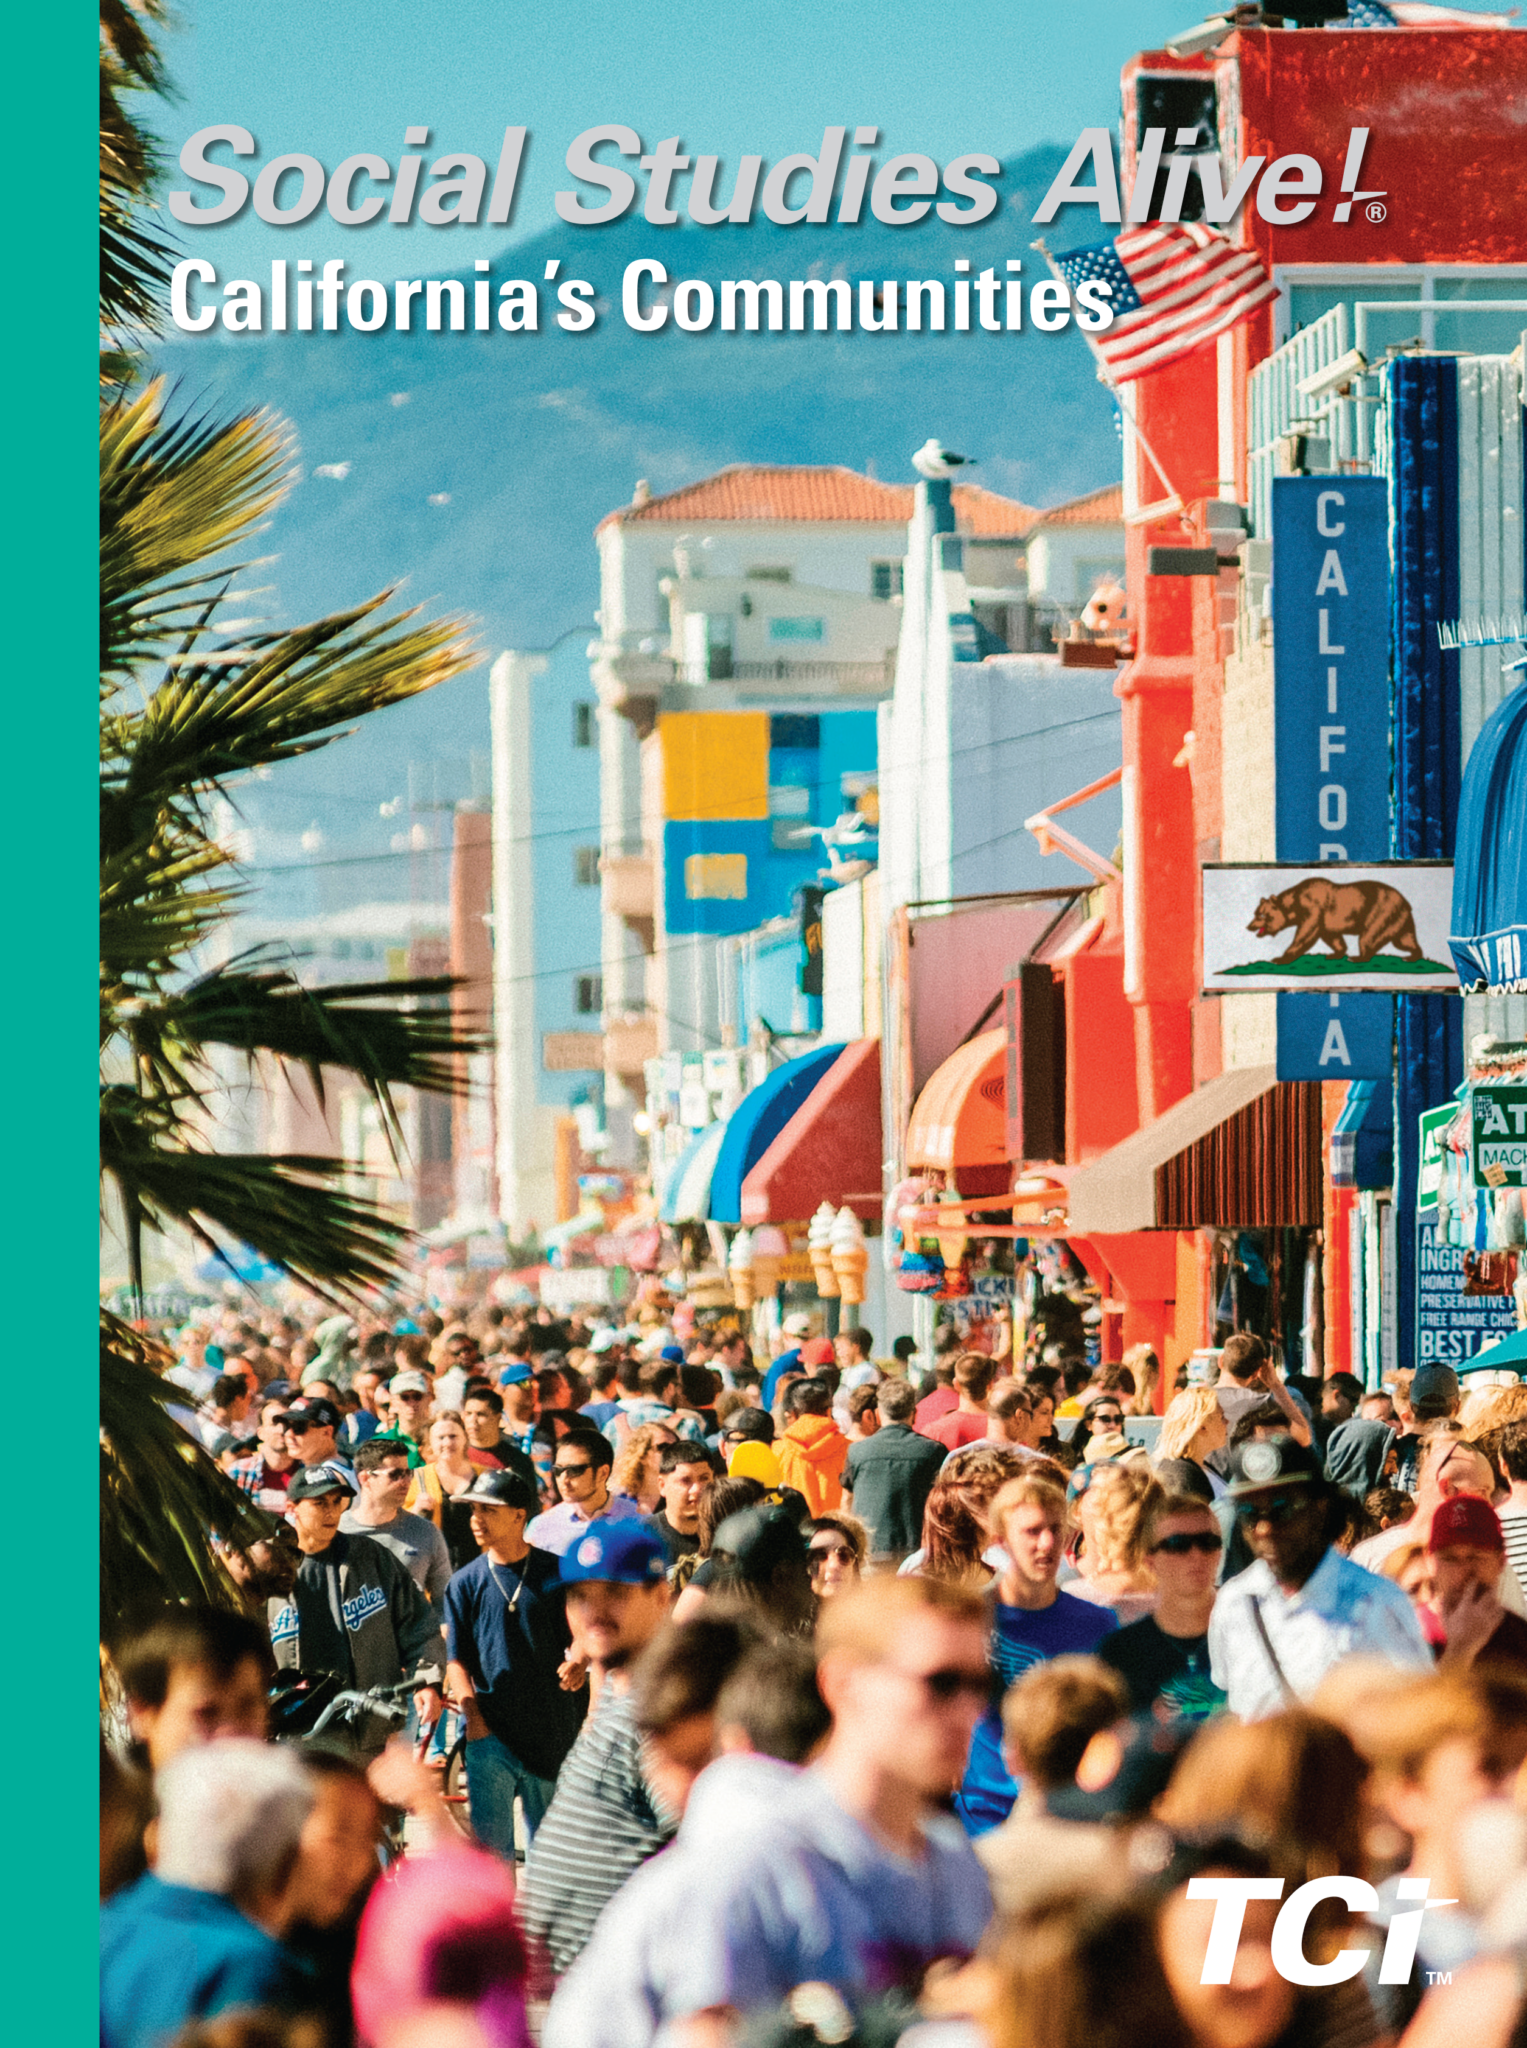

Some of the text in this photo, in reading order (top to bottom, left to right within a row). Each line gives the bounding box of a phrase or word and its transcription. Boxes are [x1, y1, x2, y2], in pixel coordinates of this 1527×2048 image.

[1315, 490, 1351, 1066] CALIFOA
[1421, 1248, 1465, 1272] INGR
[1420, 1311, 1448, 1326] FREE
[1450, 1311, 1488, 1327] RANGE
[1420, 1330, 1476, 1358] BEST
